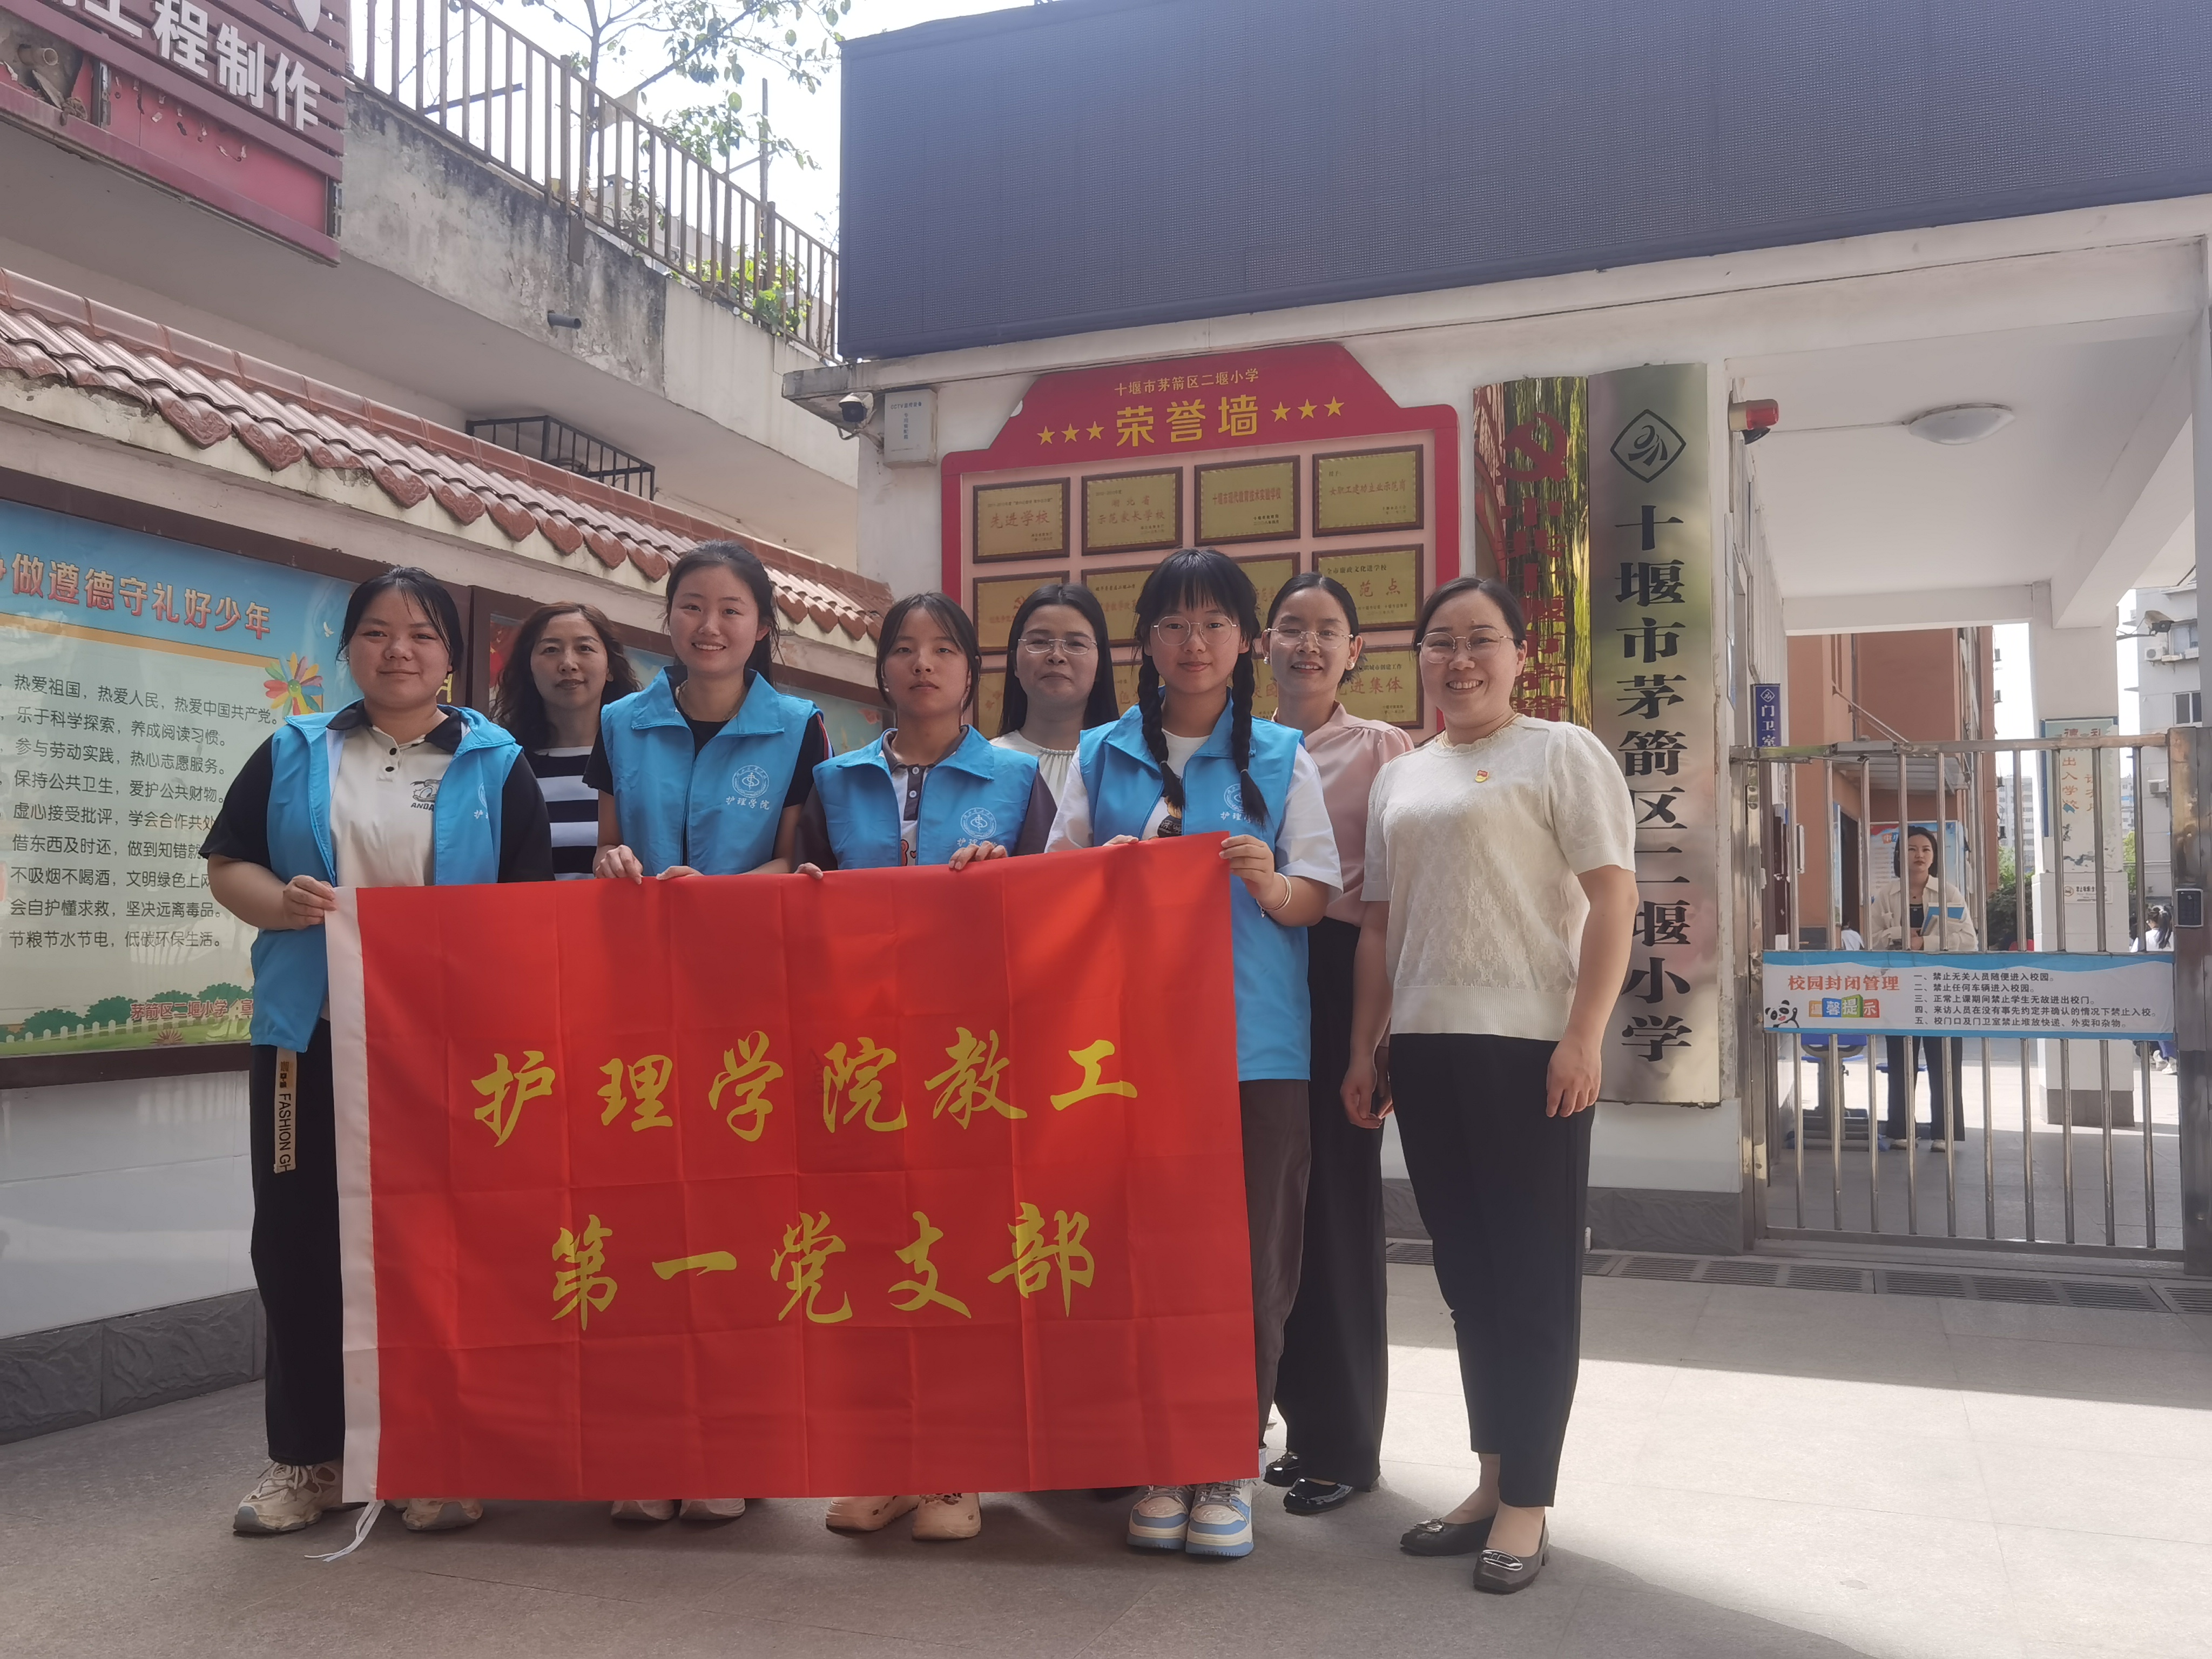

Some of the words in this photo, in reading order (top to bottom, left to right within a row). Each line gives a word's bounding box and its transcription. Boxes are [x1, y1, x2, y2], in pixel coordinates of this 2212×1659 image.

[59, 0, 320, 131] 工程制作
[1114, 368, 1259, 396] 十堰市茅箭区二堰小学
[1116, 394, 1258, 447] 荣誉墙
[990, 510, 1050, 529] 先进学校
[0, 554, 271, 639] 做遵德守礼好少年
[1341, 577, 1401, 598] 范点
[1761, 704, 1777, 747] 门卫室
[1615, 505, 1692, 1062] 十堰市茅箭区二堰小学
[474, 809, 488, 820] 护
[725, 796, 770, 810] 护理学院
[1788, 975, 1900, 991] 校园封闭管理
[131, 1000, 227, 1021] 茅箭区二堰小学
[1811, 997, 1878, 1016] 温馨提示
[470, 1027, 1138, 1147] 护理学院教工
[279, 1094, 292, 1151] FASHION
[550, 1201, 1096, 1331] 第一党支部
